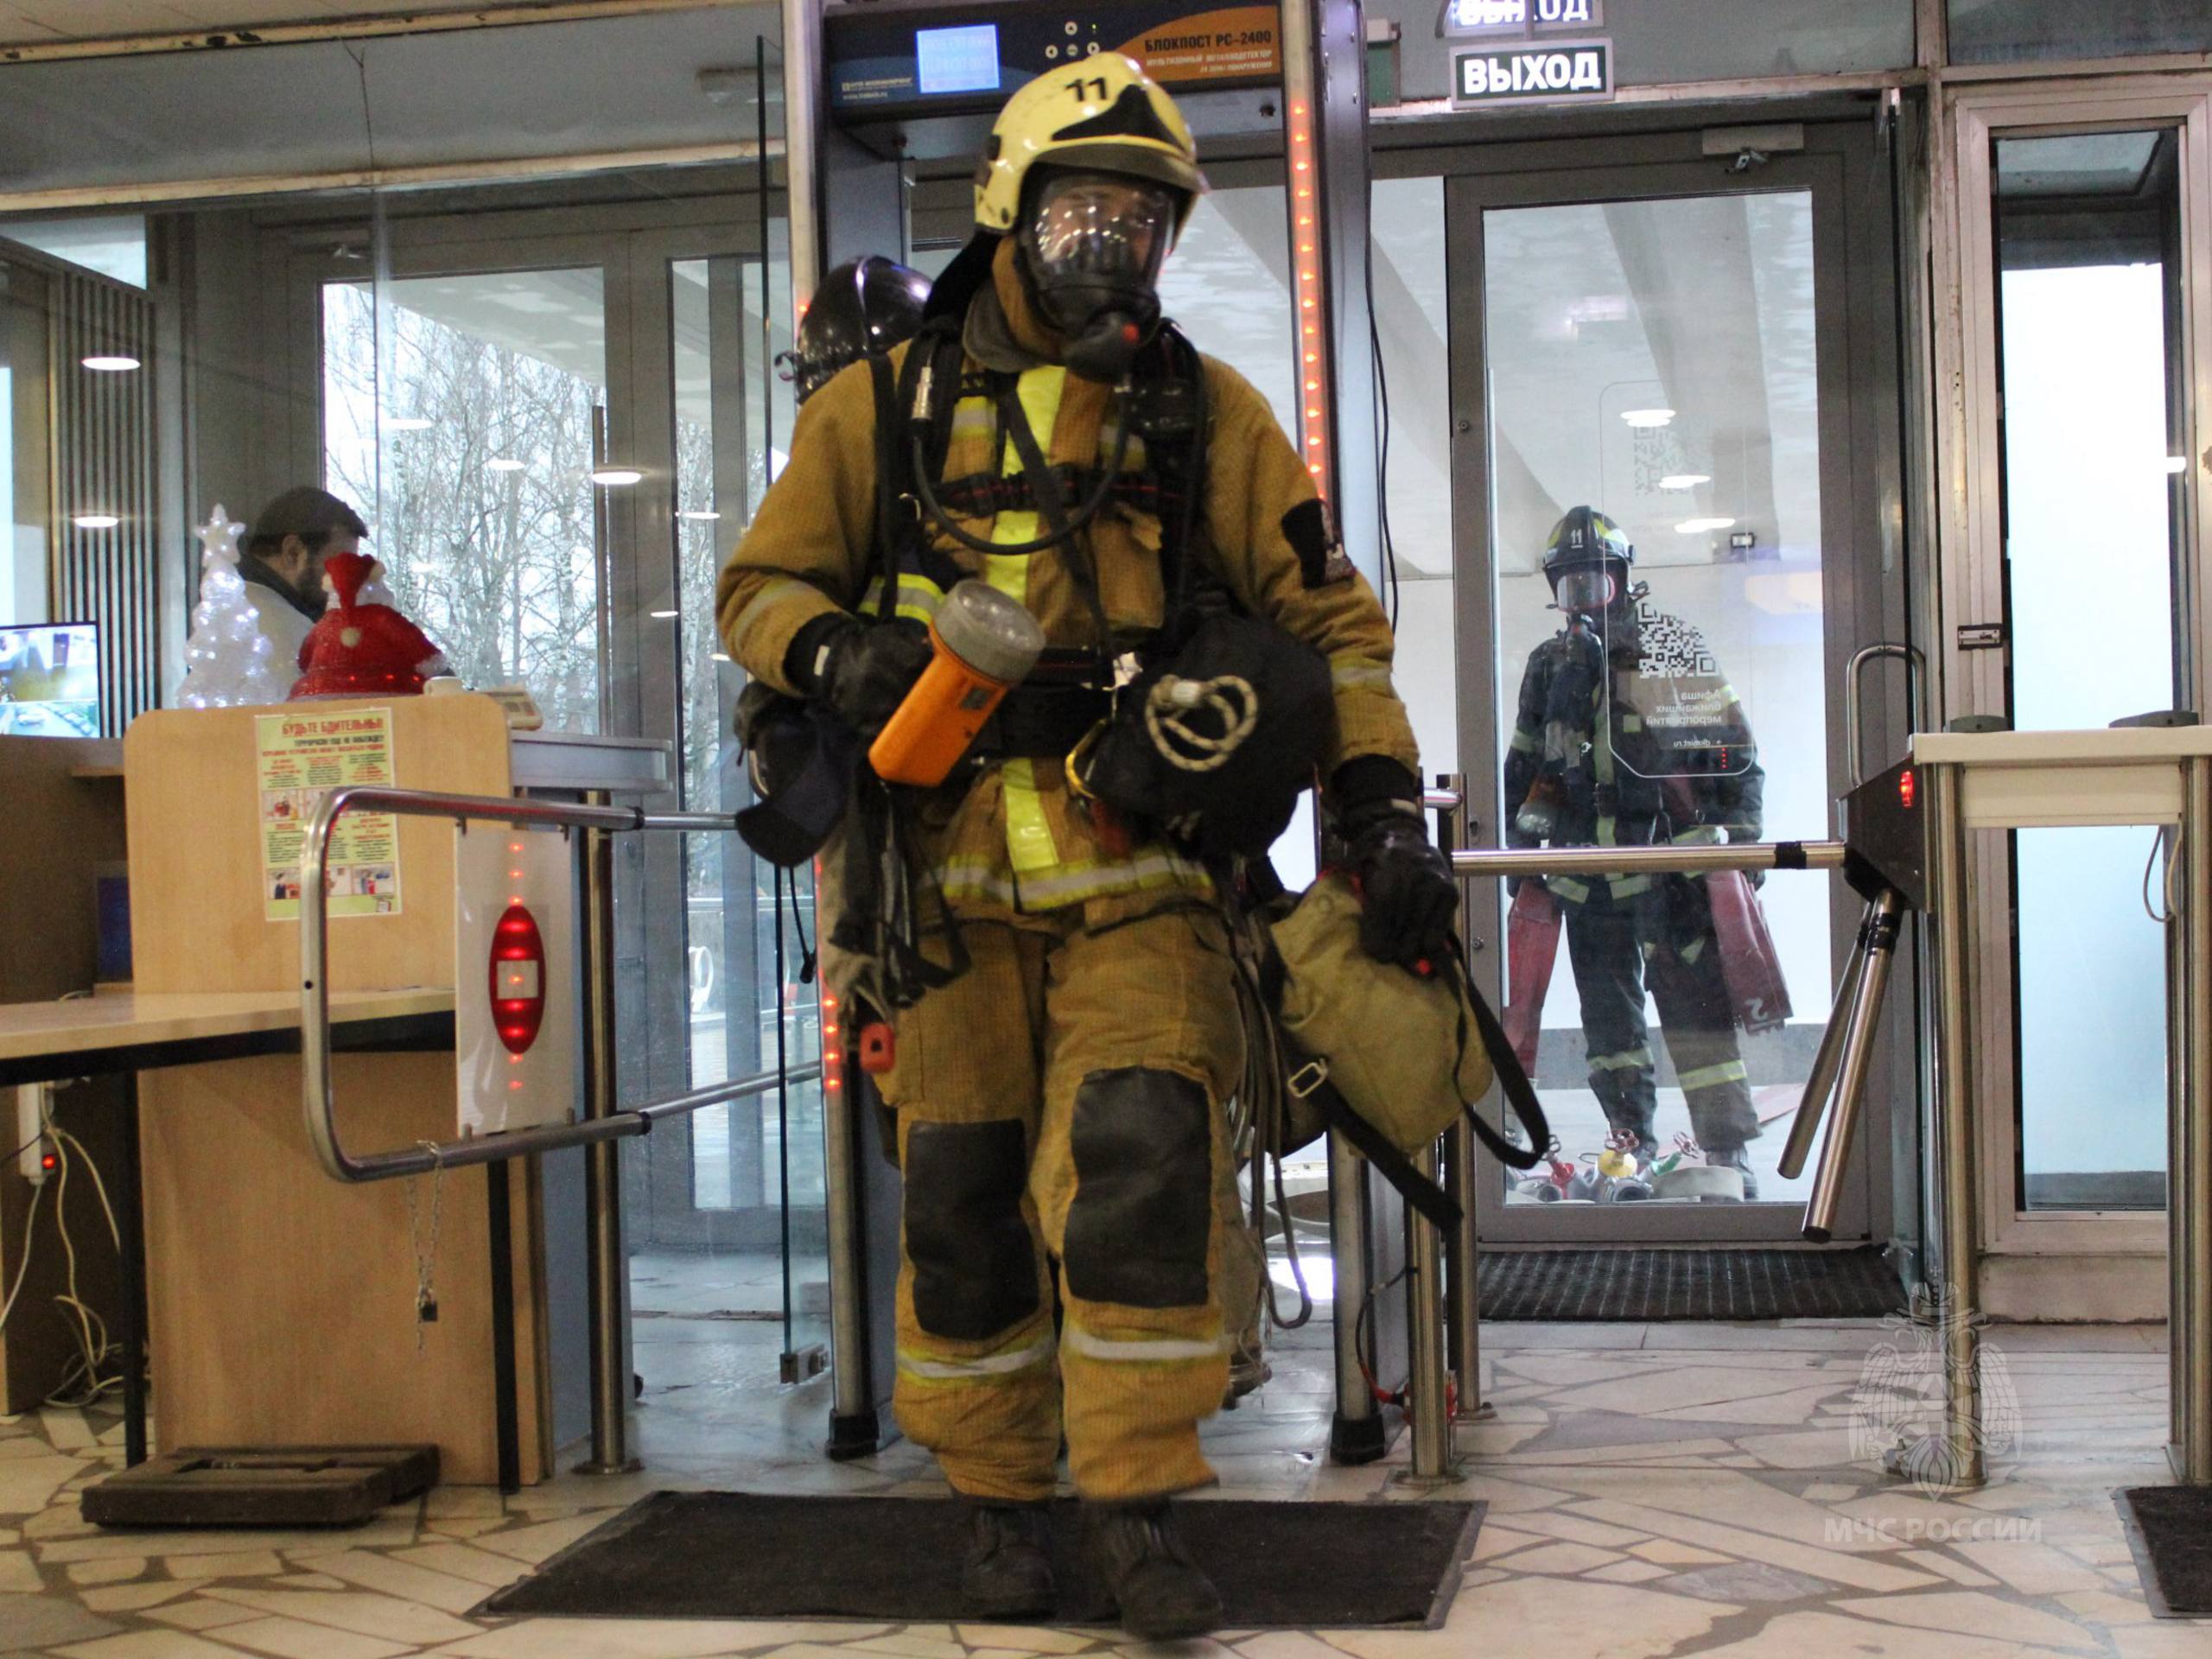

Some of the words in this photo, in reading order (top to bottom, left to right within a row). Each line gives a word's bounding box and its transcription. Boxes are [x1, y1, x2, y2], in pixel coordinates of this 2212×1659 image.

[1145, 35, 1211, 52] БЛОКПОСТ
[1464, 52, 1602, 94] ВЫХОД
[1065, 77, 1107, 102] 11
[1570, 528, 1583, 544] 11
[282, 721, 318, 737] БУДЬТЕ
